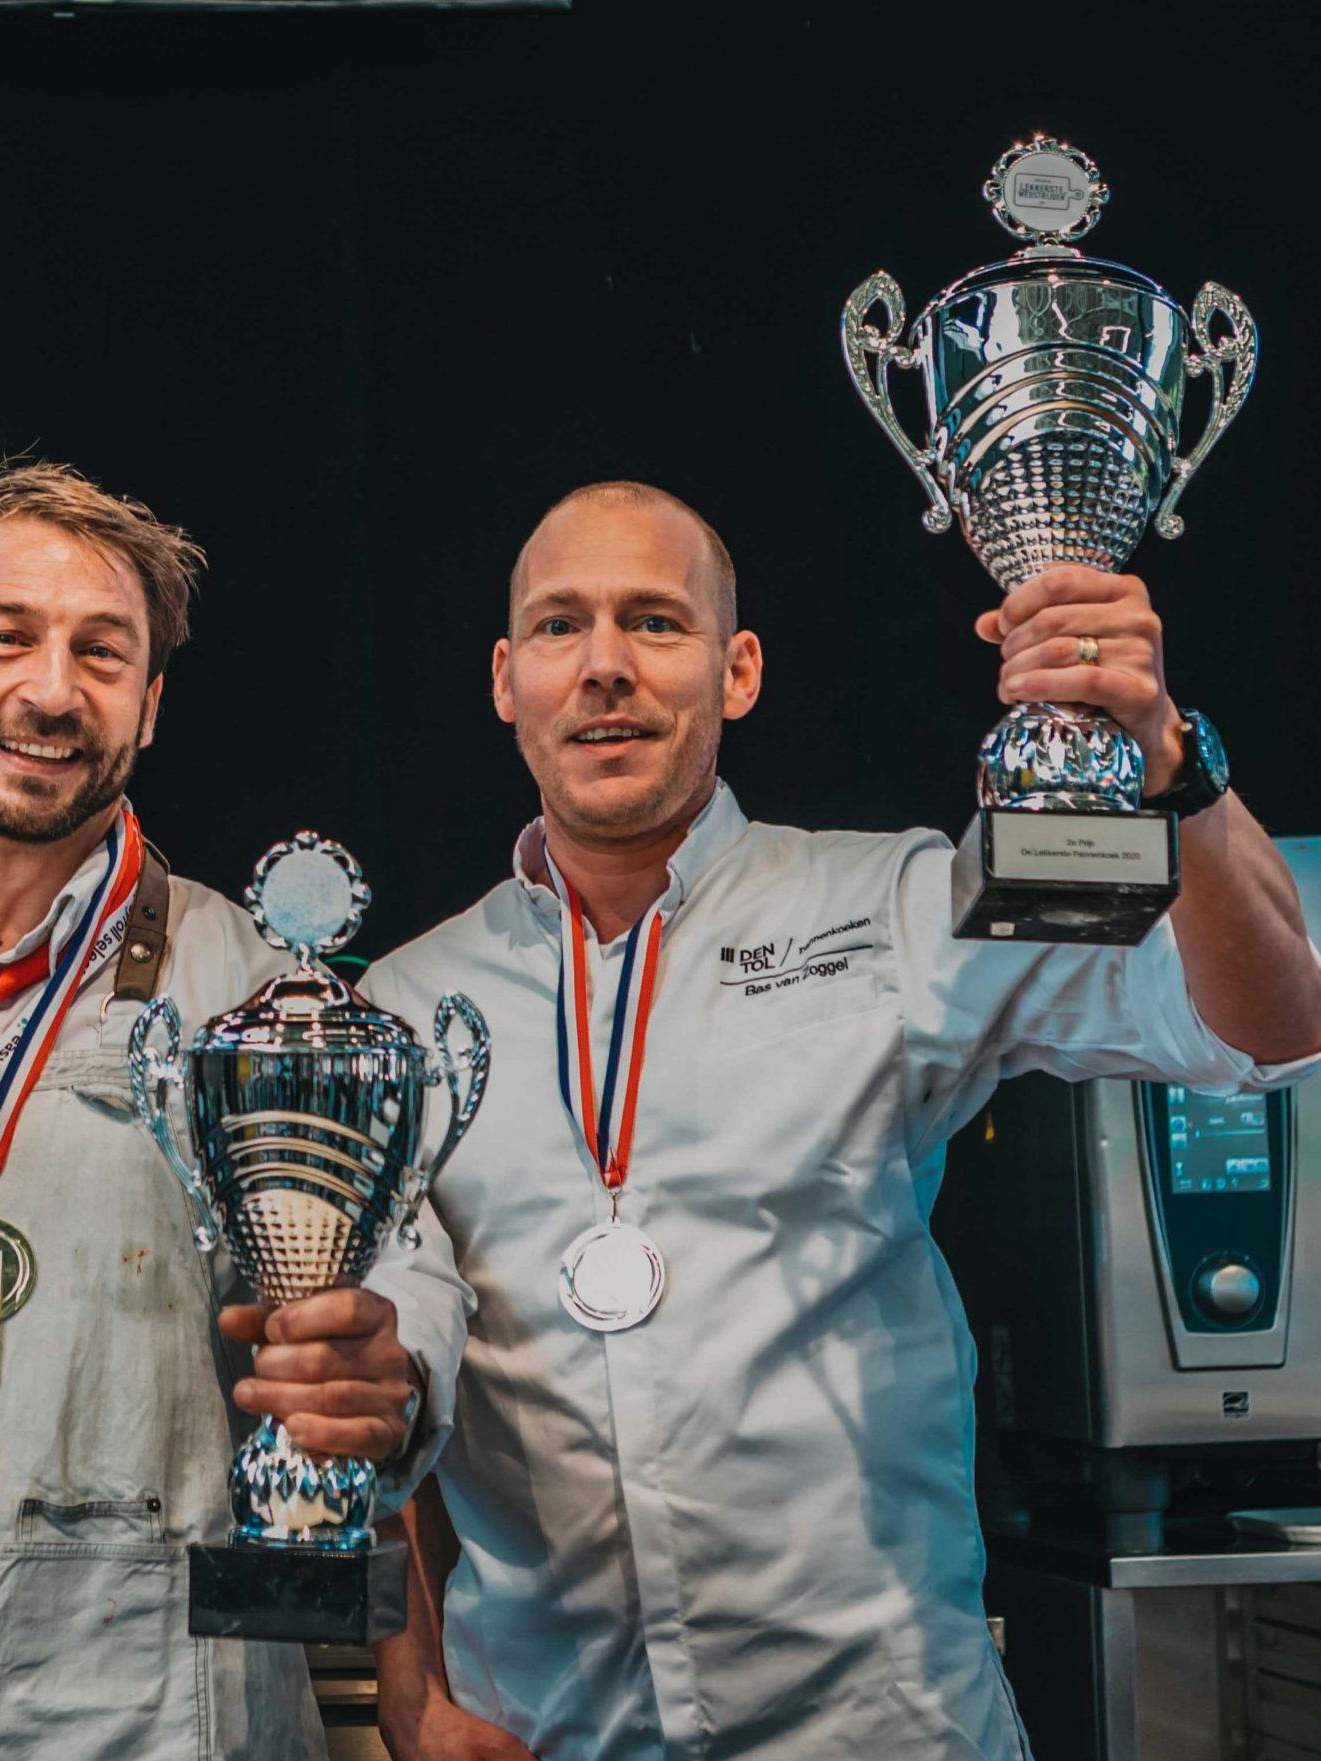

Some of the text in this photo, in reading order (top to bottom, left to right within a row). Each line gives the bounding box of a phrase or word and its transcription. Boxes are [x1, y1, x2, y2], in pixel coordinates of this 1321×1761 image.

[740, 943, 775, 962] DEN
[740, 957, 775, 974] TOL
[745, 982, 771, 996] Bas
[775, 976, 800, 988] van
